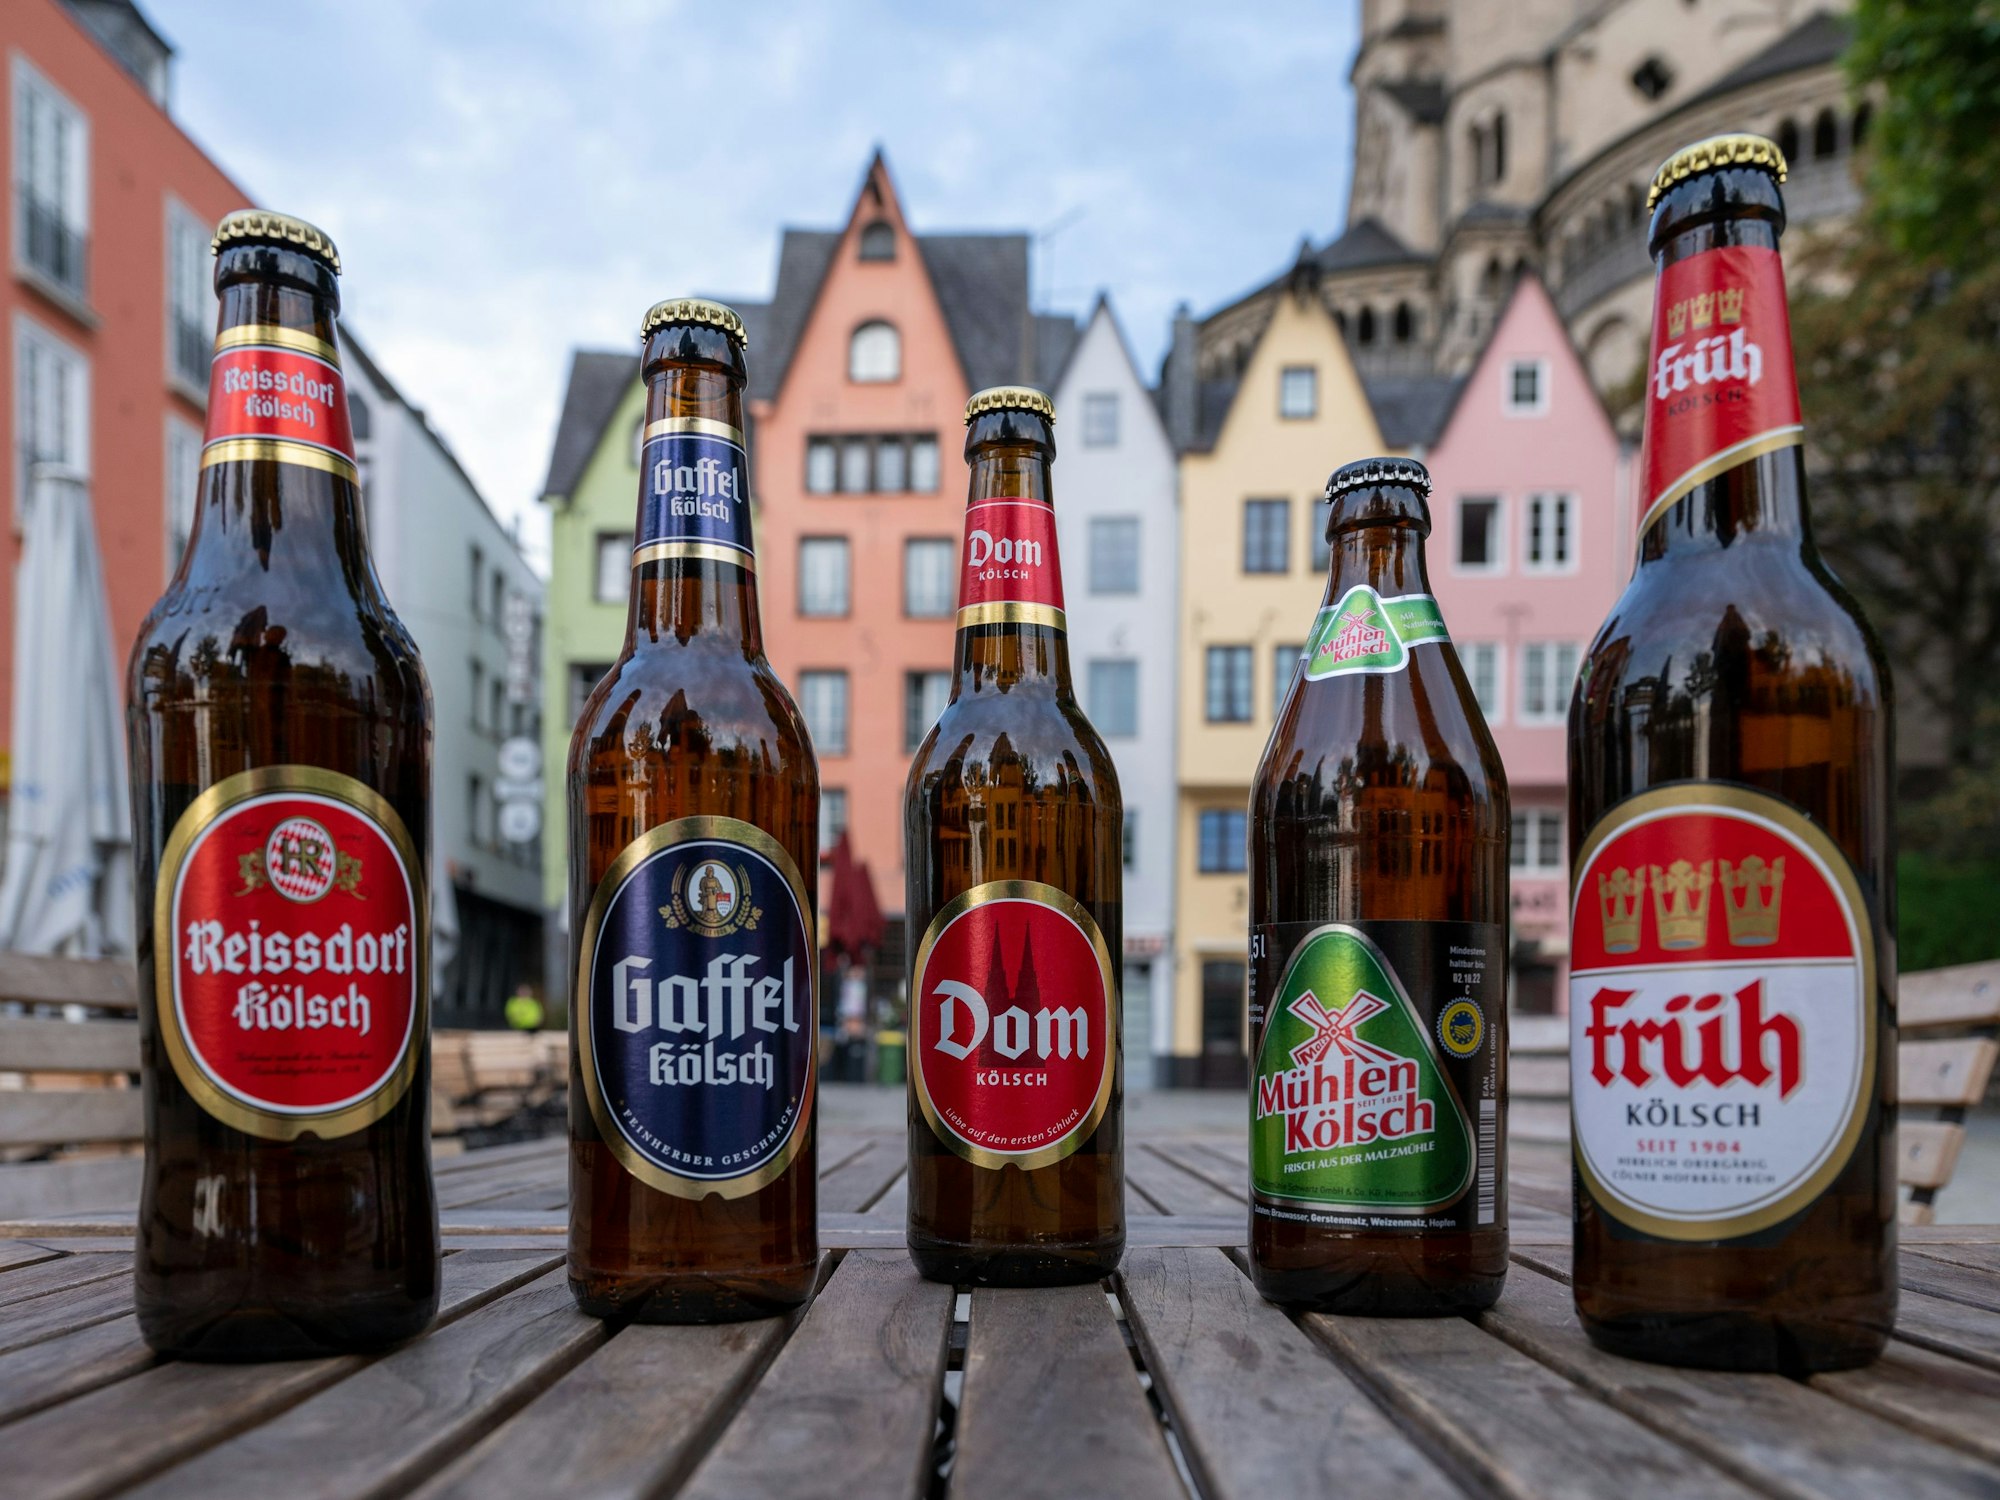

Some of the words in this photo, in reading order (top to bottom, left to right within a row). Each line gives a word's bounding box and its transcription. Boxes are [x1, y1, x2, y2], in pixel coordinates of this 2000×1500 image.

[223, 364, 335, 408] Reissdorf
[244, 393, 316, 428] Kölsch
[1668, 389, 1742, 417] KÖLSCH
[654, 457, 742, 504] Gaffel
[671, 496, 730, 523] Kölsch
[968, 529, 1042, 568] Dom
[979, 567, 1029, 580] KÖLSCH
[1319, 629, 1386, 657] Mühlen
[1333, 640, 1390, 664] Kölsch
[184, 919, 409, 976] Reissdorf
[1449, 946, 1486, 956] Mindestens
[1449, 959, 1474, 968] haltbar
[1475, 960, 1486, 969] bis:
[612, 953, 800, 1042] Gaffel
[1465, 984, 1470, 995] C
[232, 981, 372, 1037] Kölsch
[931, 979, 1090, 1062] Dom
[649, 1040, 775, 1091] Kölsch
[1299, 1037, 1328, 1067] Malz
[976, 1069, 1048, 1087] KÖLSCH
[1258, 1058, 1417, 1117] Mühlen
[1357, 1098, 1376, 1109] SEIT
[1382, 1094, 1403, 1104] 1858
[1626, 1098, 1761, 1127] KÖLSCH
[622, 1108, 714, 1166] FEINHERBER
[721, 1105, 793, 1165] GESCHMACK
[945, 1107, 967, 1130] Liebe
[967, 1127, 988, 1141] auf
[987, 1133, 1007, 1144] den
[1010, 1132, 1045, 1145] ersten
[1046, 1108, 1080, 1137] Schluck
[1287, 1091, 1433, 1151] Kölsch
[1284, 1160, 1316, 1174] FRISCH
[1317, 1157, 1338, 1170] AUS
[1340, 1154, 1362, 1166] DER
[1364, 1140, 1436, 1162] MALZMÜHLE
[1637, 1139, 1677, 1152] SEIT
[1690, 1140, 1741, 1153] 1904
[1319, 1186, 1344, 1195] GmbH
[1271, 1208, 1310, 1222] Brauwasser,
[1310, 1213, 1368, 1227] Gerstenmalz,
[1370, 1217, 1428, 1228] Weizenmalz,
[1429, 1218, 1456, 1229] Hopfen
